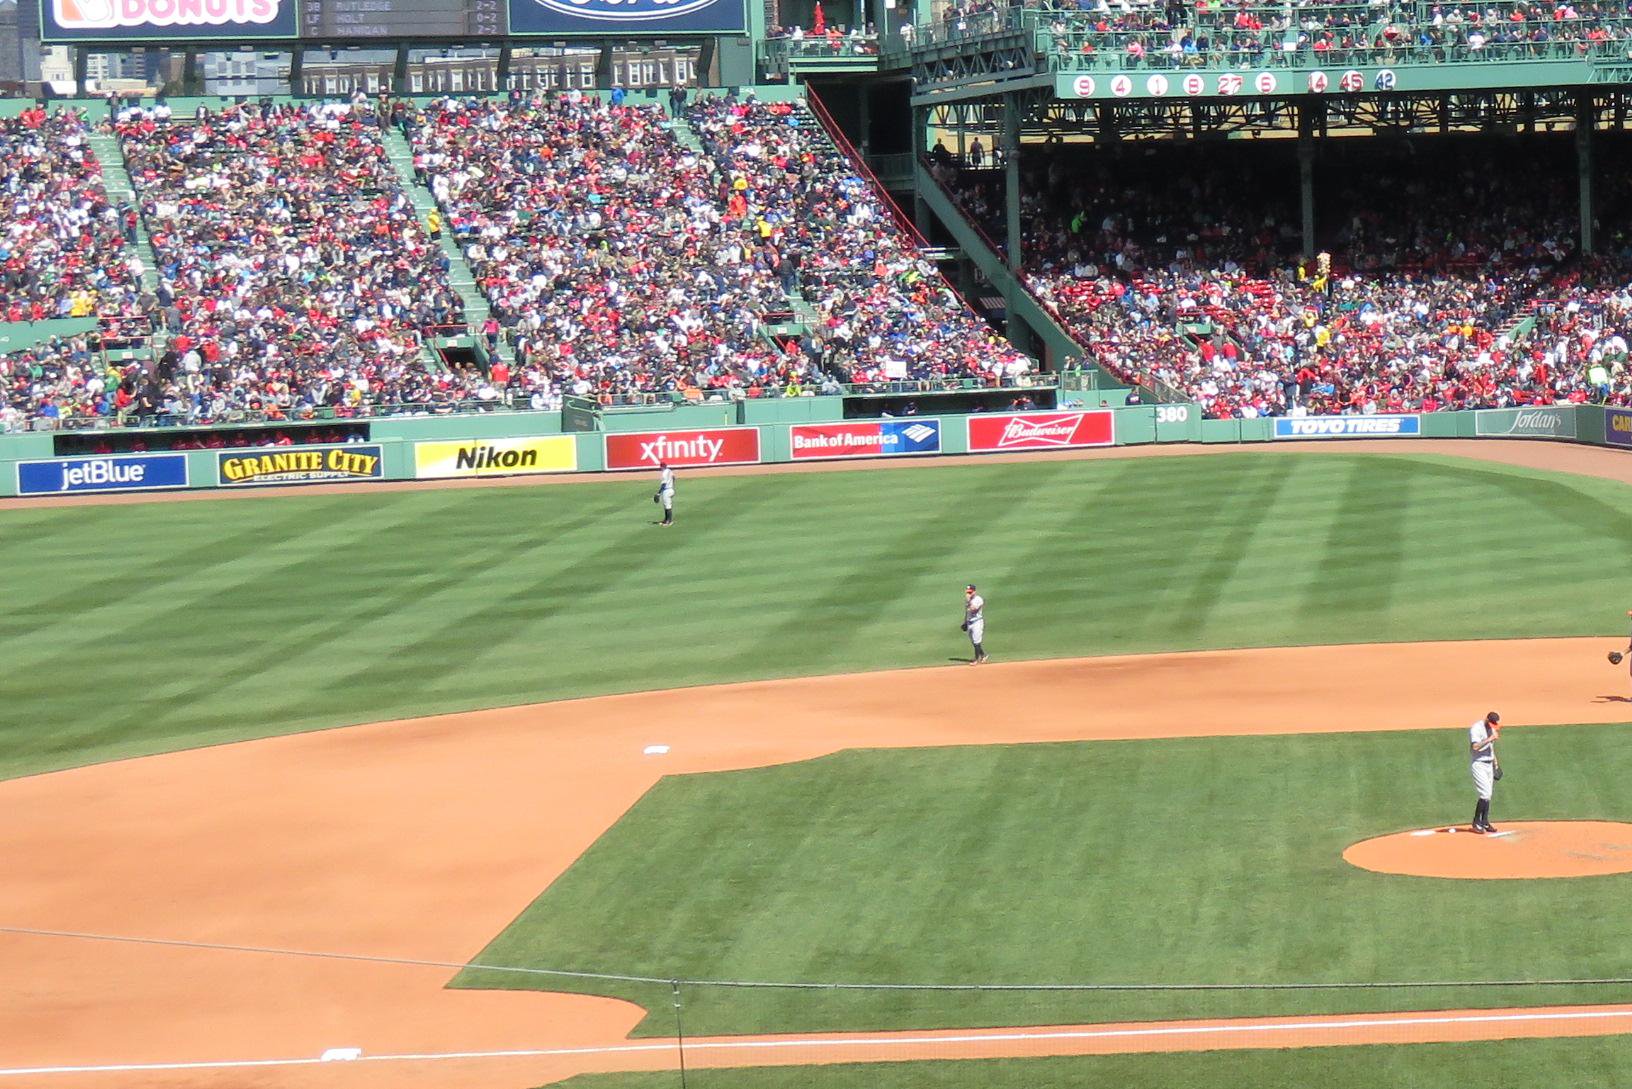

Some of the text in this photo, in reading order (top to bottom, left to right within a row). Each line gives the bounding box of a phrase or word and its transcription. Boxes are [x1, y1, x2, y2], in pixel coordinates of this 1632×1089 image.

[1079, 80, 1090, 95] 9
[1115, 80, 1126, 93] 4
[1188, 79, 1199, 94] 8
[1217, 75, 1244, 94] 27
[1261, 76, 1271, 92] 6
[1308, 74, 1326, 92] 14
[1339, 73, 1364, 91] 45
[1374, 72, 1393, 90] 42
[1156, 406, 1187, 423] 380
[1505, 410, 1562, 433] Jordan's
[1005, 424, 1077, 439] Budweiser
[1291, 418, 1401, 434] TOYO TIRES
[794, 431, 898, 449] Bank of America
[456, 446, 538, 469] Nikon
[61, 460, 145, 490] jetBlue
[253, 473, 307, 482] ELECTRIC
